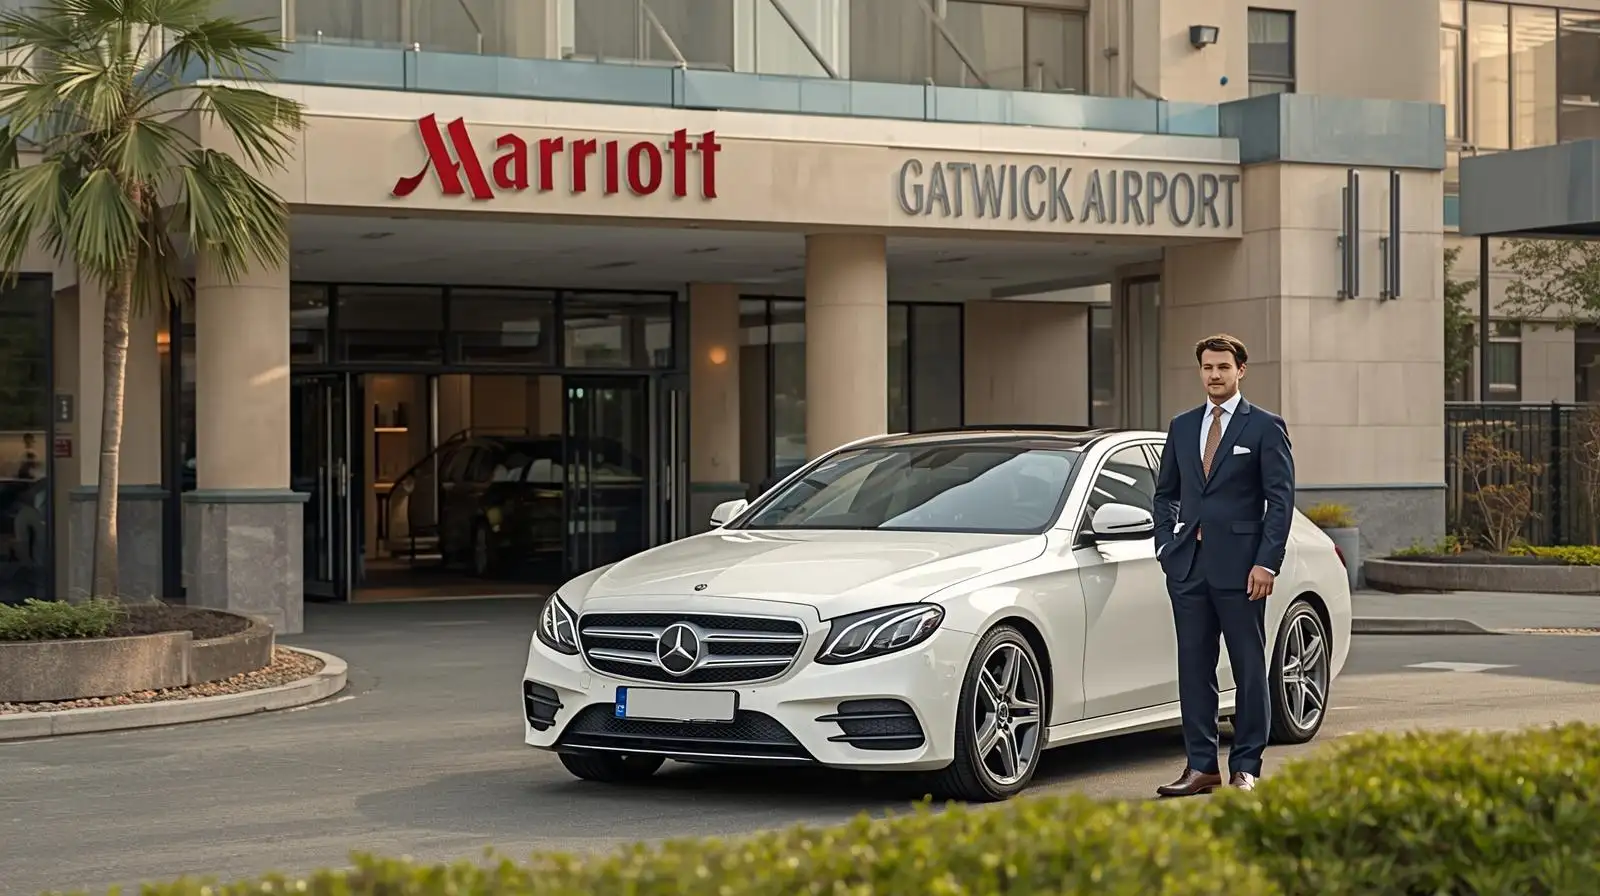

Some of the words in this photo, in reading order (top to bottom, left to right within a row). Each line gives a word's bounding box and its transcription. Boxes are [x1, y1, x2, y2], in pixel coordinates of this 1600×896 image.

[391, 112, 722, 200] Marriott
[898, 158, 1074, 223] GATWICK
[1080, 168, 1240, 229] AIRPORT
